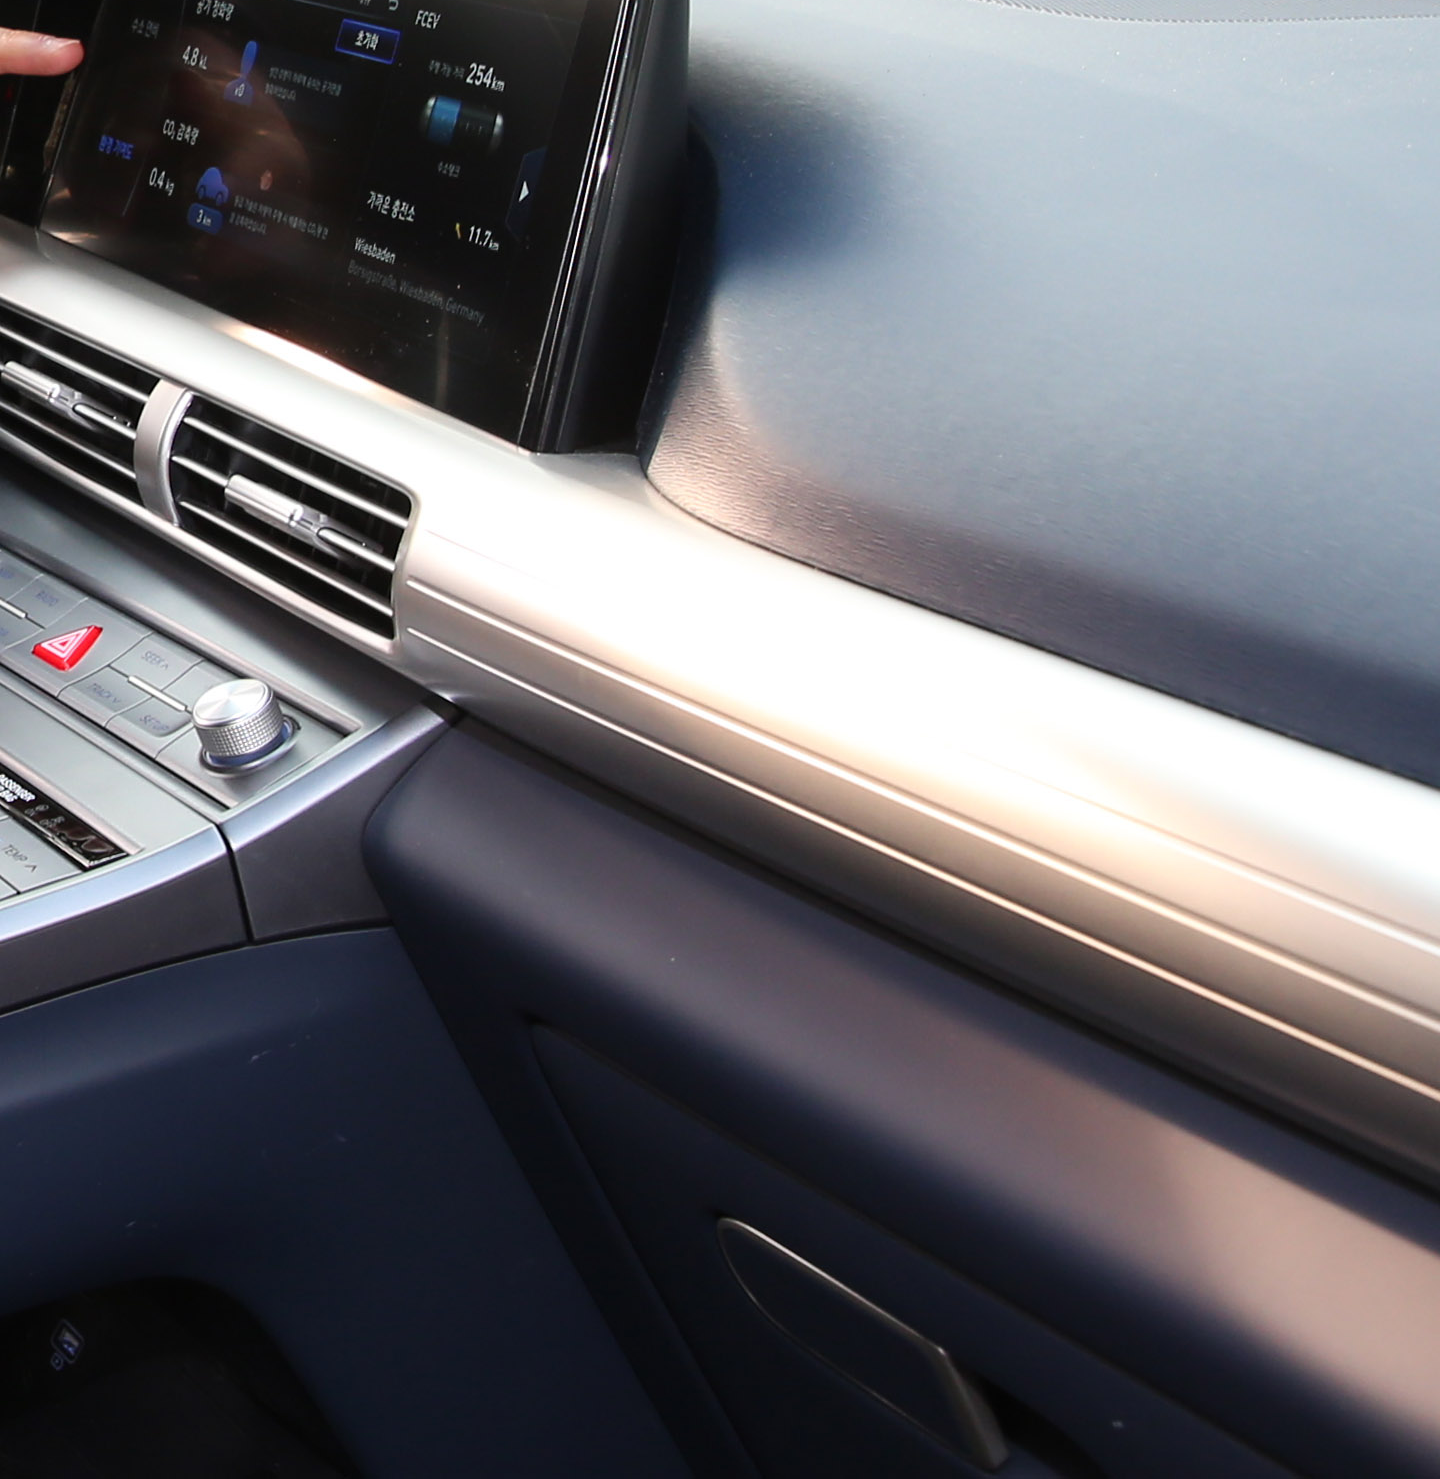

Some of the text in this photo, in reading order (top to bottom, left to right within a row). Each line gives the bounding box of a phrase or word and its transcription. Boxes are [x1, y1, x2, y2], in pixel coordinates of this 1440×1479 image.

[211, 0, 235, 21] 정화량
[415, 9, 441, 30] FCEV
[354, 28, 379, 51] 초기화
[181, 44, 200, 67] 4.8
[175, 122, 200, 146] 감축량
[149, 166, 166, 189] 0.4
[391, 199, 416, 222] 충전소
[354, 236, 396, 265] Wiesbaden
[445, 296, 487, 328] Germany
[1, 843, 28, 863] TEMP
